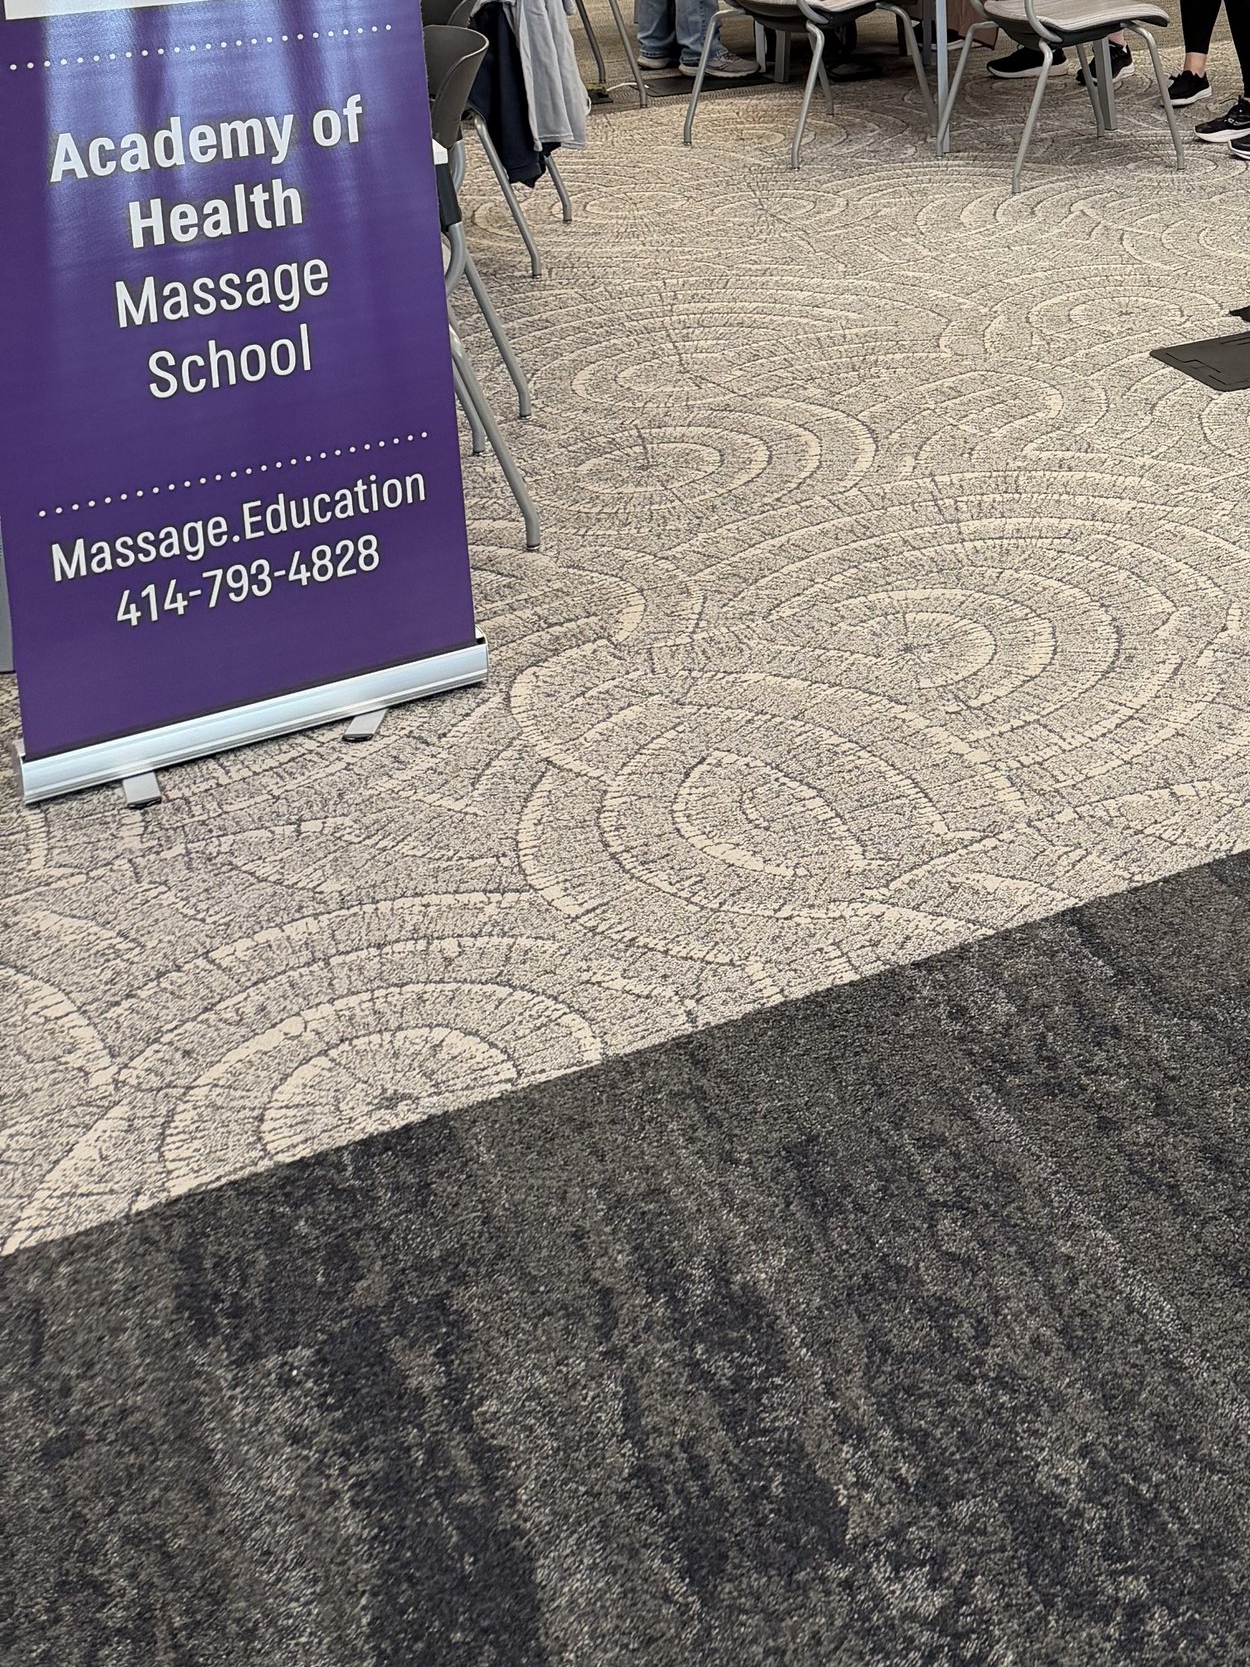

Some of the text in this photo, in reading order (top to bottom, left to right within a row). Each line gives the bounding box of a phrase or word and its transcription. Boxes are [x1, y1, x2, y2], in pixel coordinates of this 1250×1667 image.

[49, 94, 364, 183] Academy of
[128, 178, 303, 249] Health
[115, 257, 330, 328] Massage
[147, 324, 313, 399] School
[50, 470, 427, 582] Massage.Education
[116, 535, 381, 628] 414-793-4828
